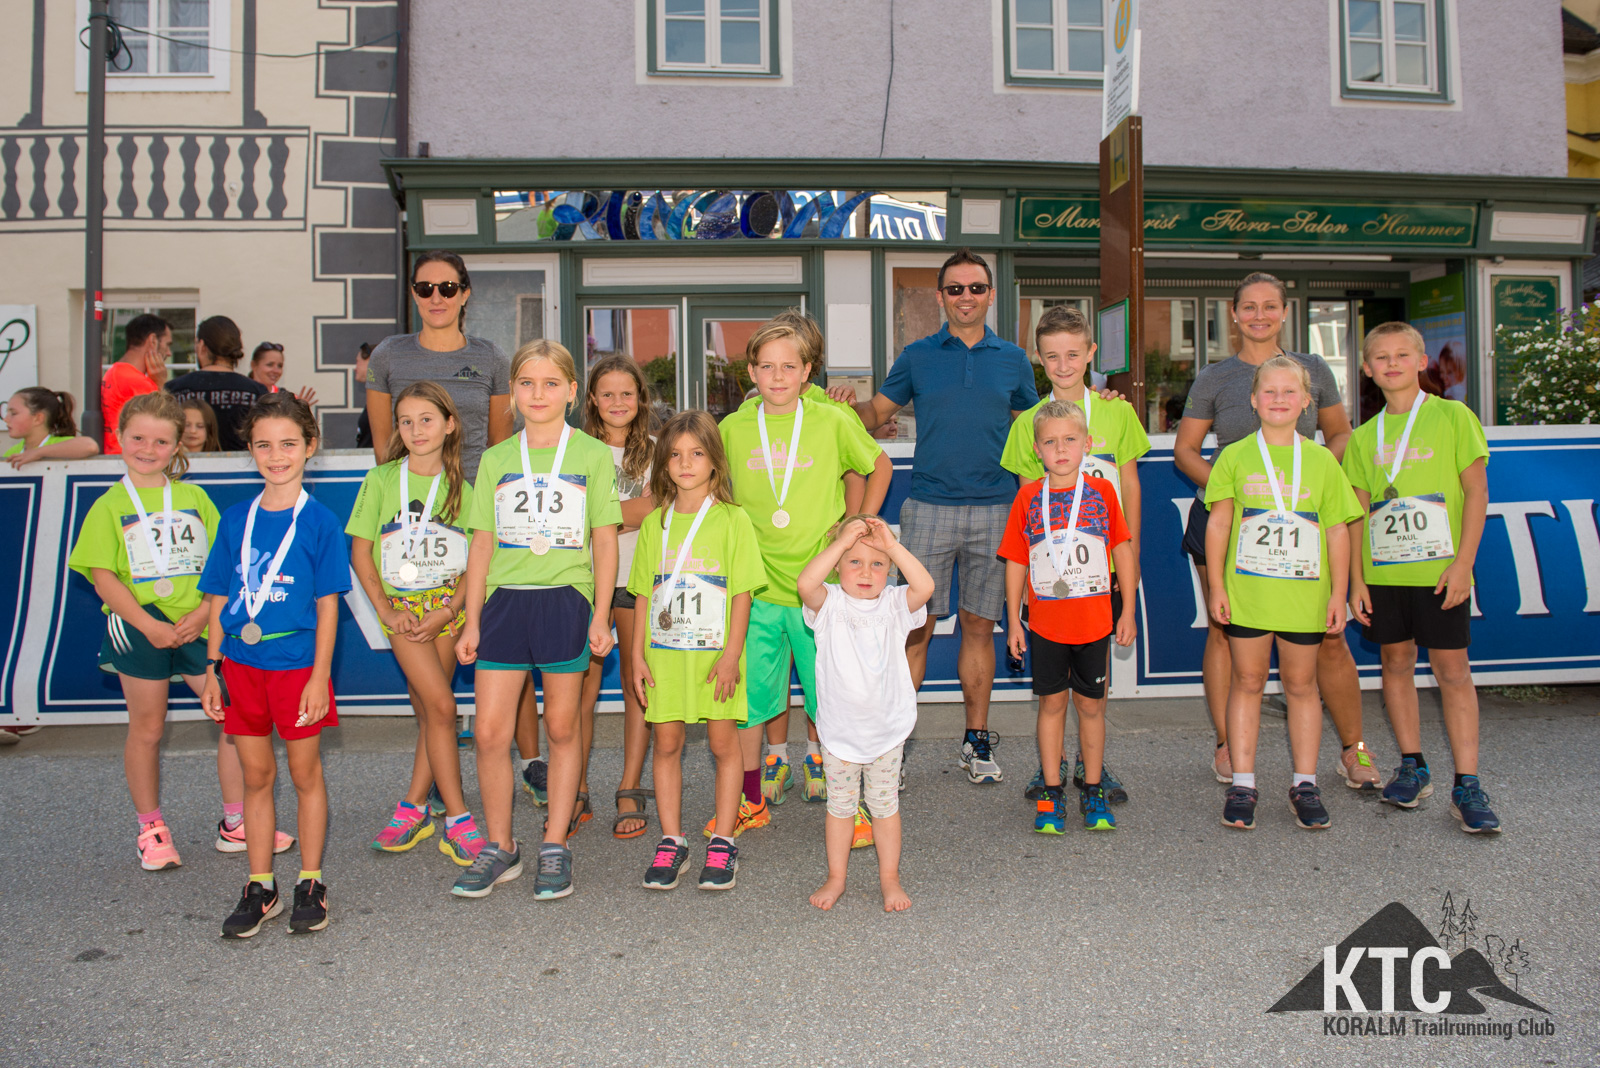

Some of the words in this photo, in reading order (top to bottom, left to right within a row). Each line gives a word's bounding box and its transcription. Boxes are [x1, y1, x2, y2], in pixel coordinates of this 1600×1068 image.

[1034, 205, 1178, 231] Marrist
[1201, 208, 1349, 235] Flora-Salon
[1361, 212, 1465, 238] Hammer
[175, 391, 207, 405] OCK
[514, 490, 564, 514] 213
[1384, 511, 1428, 535] 210
[1256, 525, 1299, 548] 211
[1397, 534, 1418, 542] PAUL
[1268, 548, 1288, 557] LENI
[1062, 567, 1082, 577] AVID
[672, 617, 692, 625] JANA
